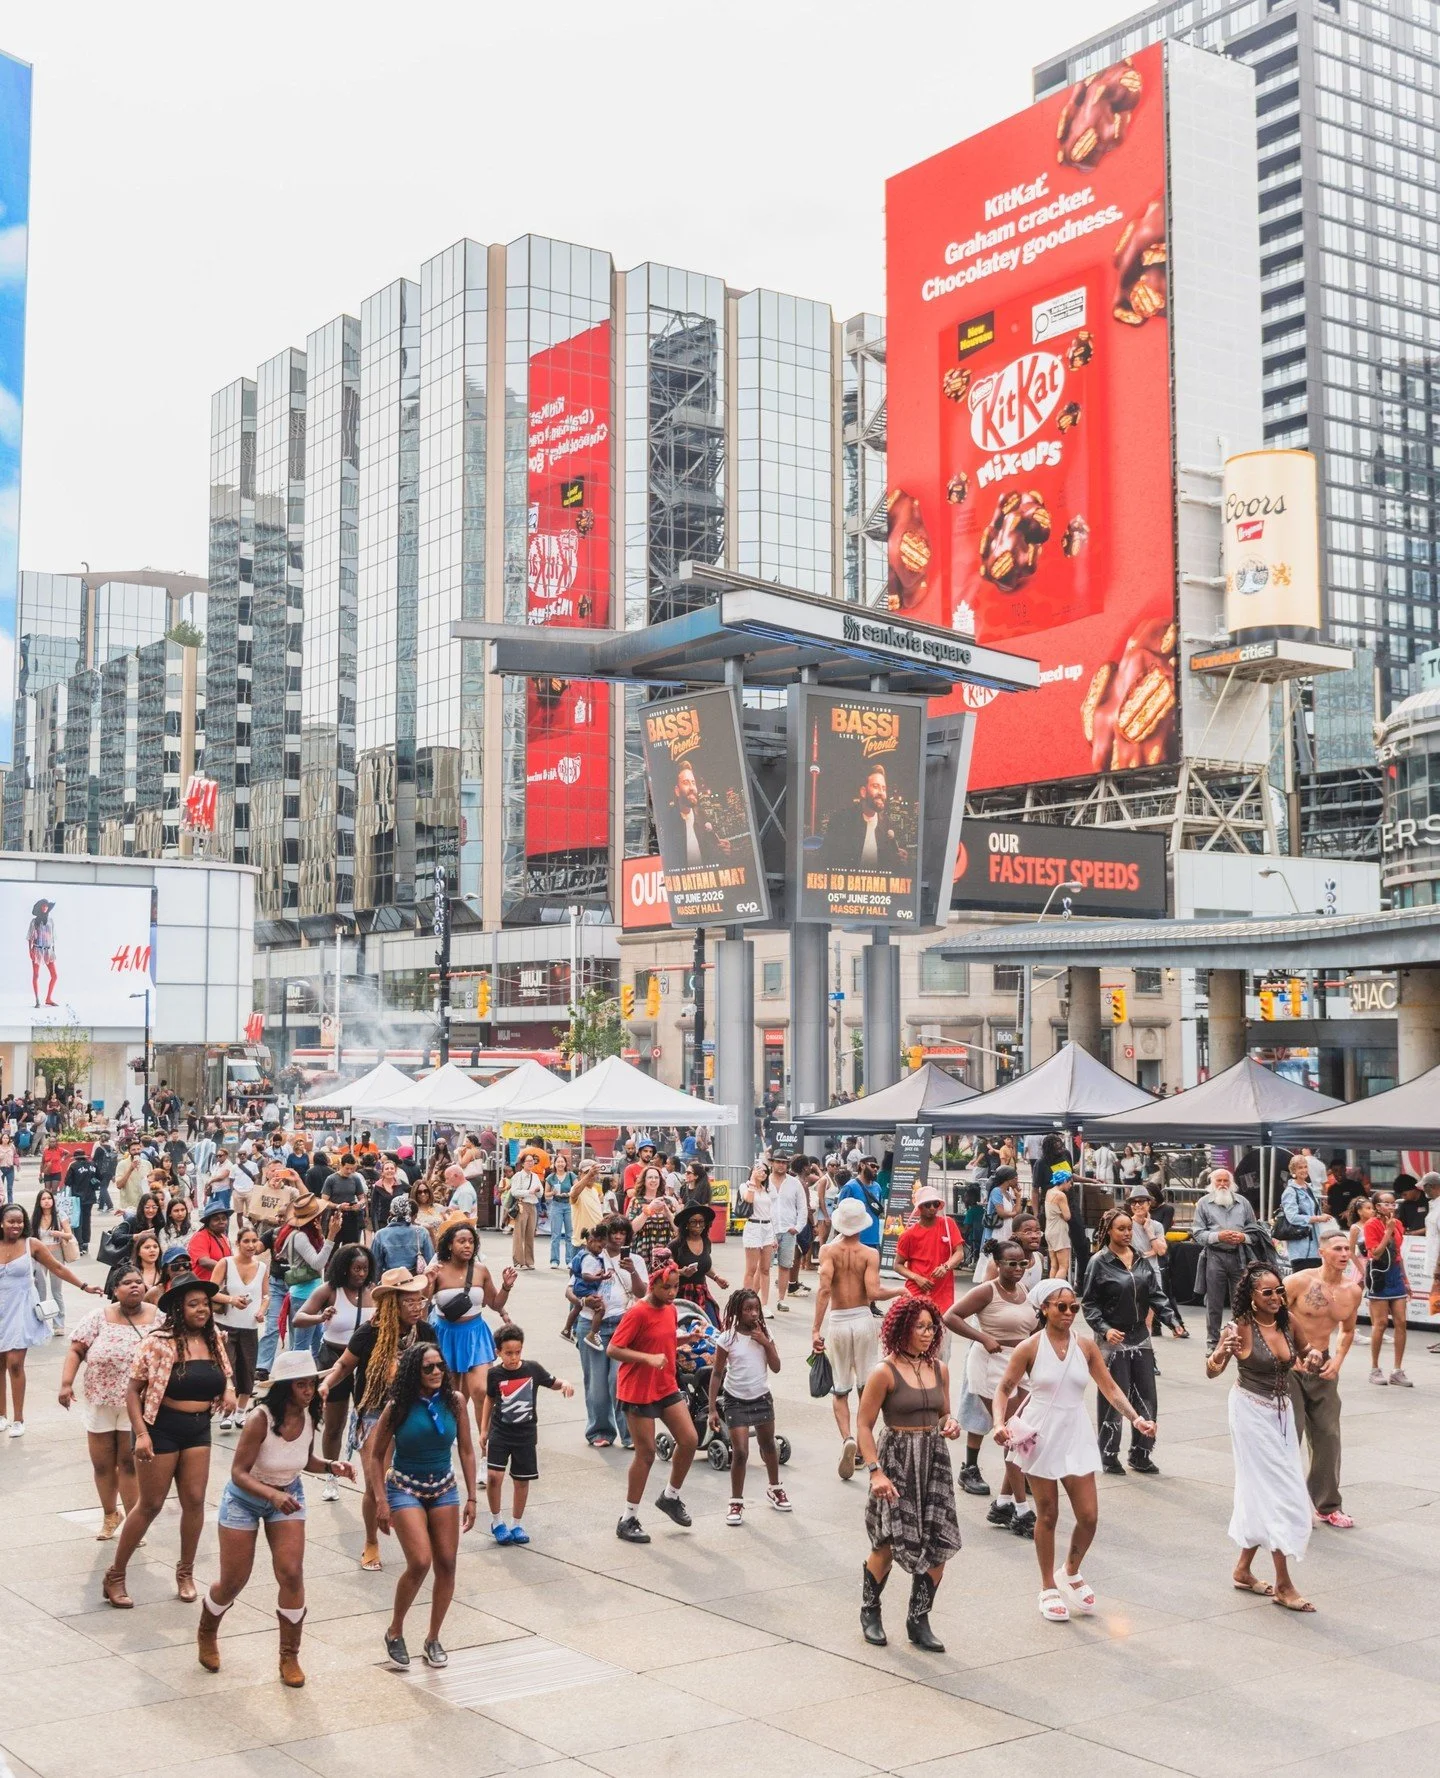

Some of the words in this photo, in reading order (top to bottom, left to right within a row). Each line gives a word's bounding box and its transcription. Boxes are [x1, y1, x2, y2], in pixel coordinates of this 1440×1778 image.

[944, 220, 1016, 264] Graham
[1018, 187, 1095, 233] cracker.
[921, 246, 1020, 301] Chocolatey
[1022, 205, 1124, 265] goodness.
[981, 354, 1060, 448] KitKat
[1226, 493, 1287, 523] Coors
[862, 625, 922, 652] sankofa
[923, 640, 972, 664] square
[646, 709, 700, 743] BASSI
[831, 707, 899, 738] BASSI
[861, 734, 899, 757] Toronto
[989, 832, 1020, 853] OUR
[718, 867, 745, 888] MAT
[830, 873, 845, 891] KO
[847, 874, 887, 893] BATANA
[889, 877, 912, 895] MAT
[989, 854, 1067, 887] FASTEST
[1070, 858, 1140, 892] SPEEDS
[631, 870, 669, 907] OUR
[702, 890, 724, 902] 2026
[847, 895, 868, 904] JUNE
[869, 895, 891, 905] 2026
[700, 903, 723, 914] HALL
[830, 904, 865, 915] MASSEY
[866, 905, 888, 916] HALL
[110, 944, 152, 973] H&M
[1352, 981, 1397, 1011] SHAC
[997, 1032, 1013, 1042] fido
[261, 1195, 280, 1204] BEST
[261, 1201, 278, 1210] BUY
